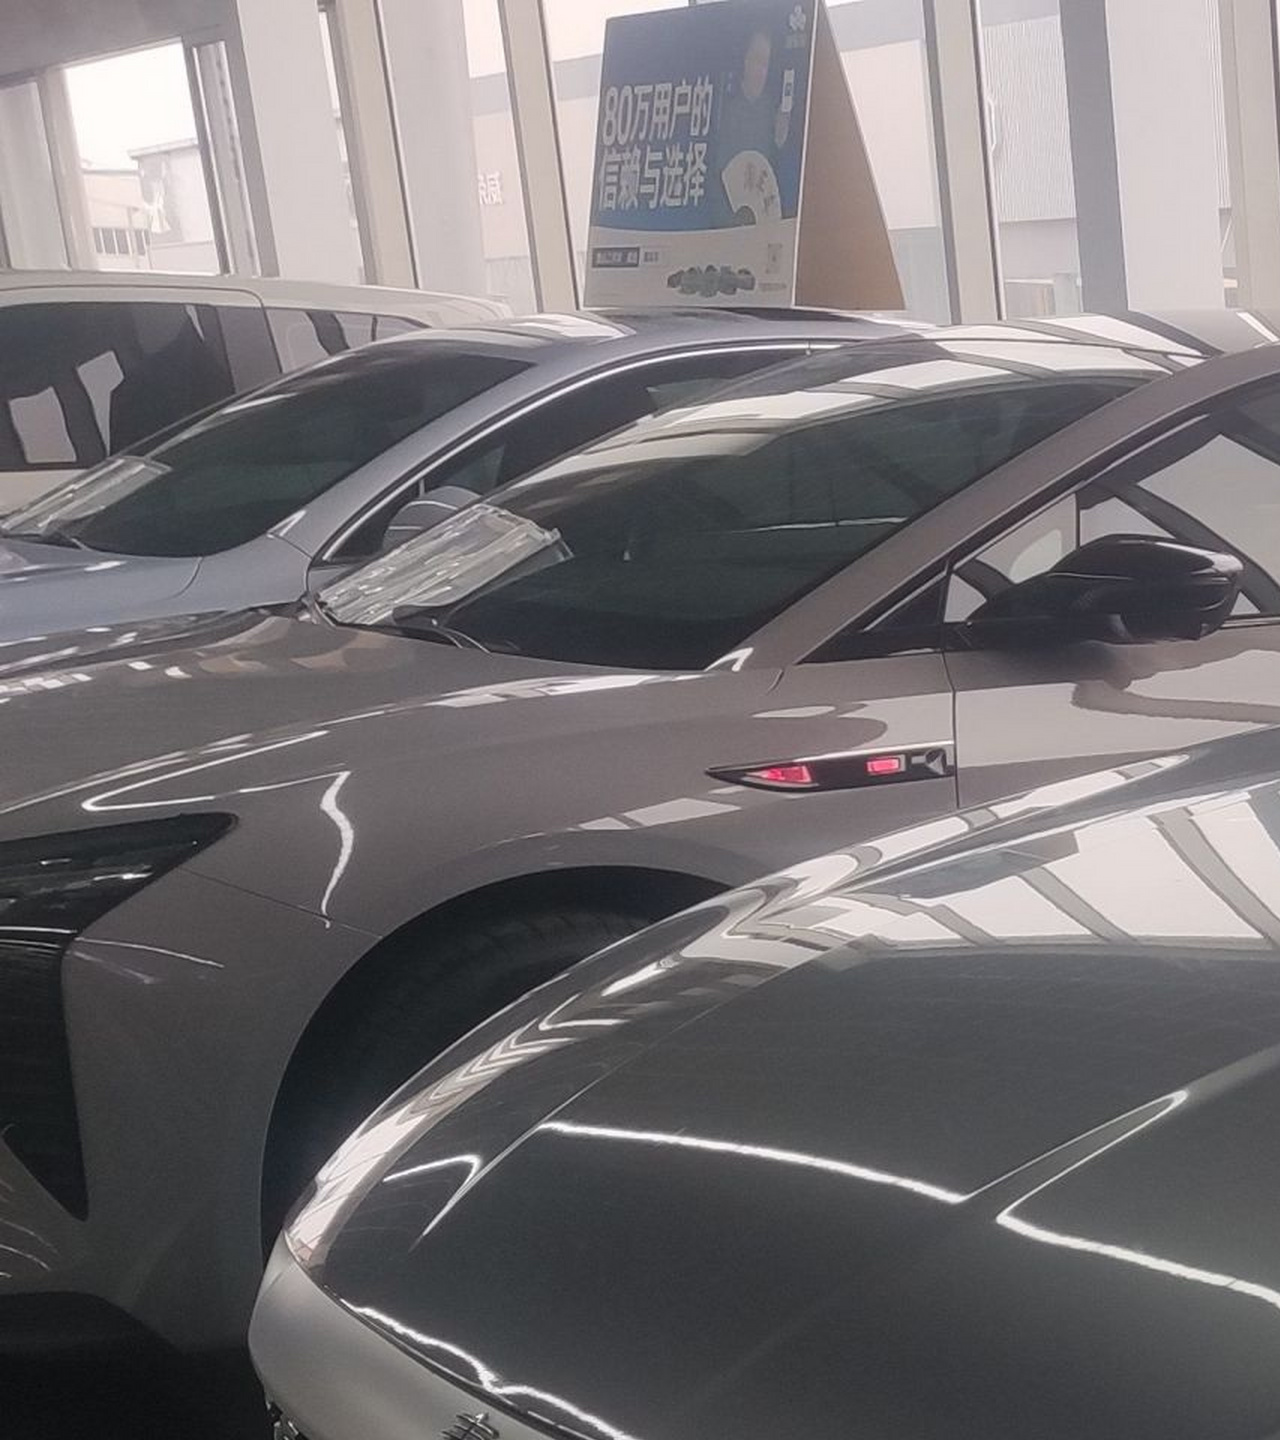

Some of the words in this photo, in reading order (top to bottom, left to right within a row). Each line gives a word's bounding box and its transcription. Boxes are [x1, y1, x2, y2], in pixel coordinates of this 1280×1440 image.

[602, 76, 713, 146] 80万用户的
[599, 142, 708, 210] 信赖与选择
